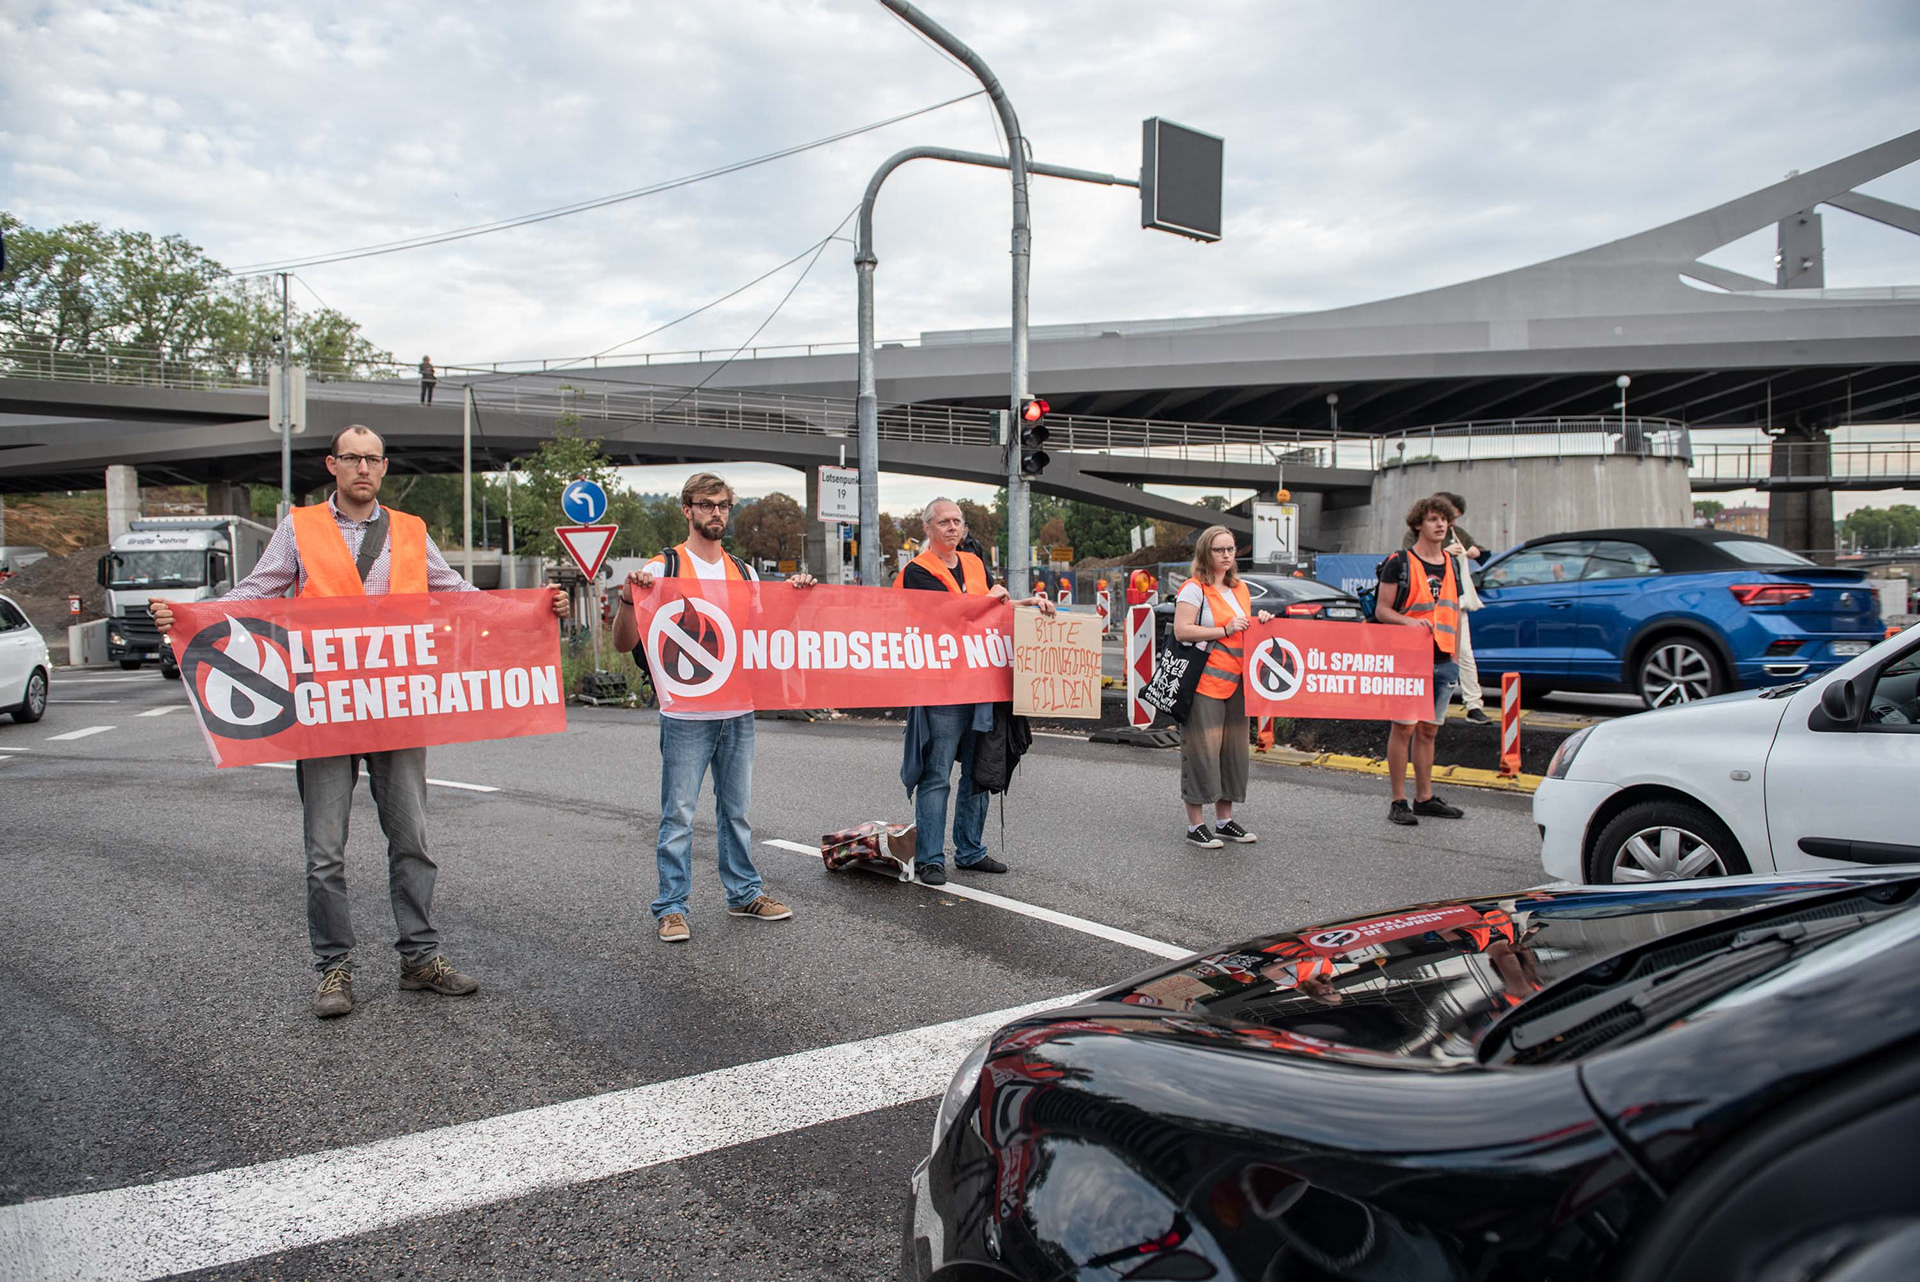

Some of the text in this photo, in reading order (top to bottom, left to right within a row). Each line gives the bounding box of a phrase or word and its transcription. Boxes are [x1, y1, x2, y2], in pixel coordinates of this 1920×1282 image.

[821, 472, 860, 486] Lotsenpunk
[837, 489, 847, 499] 19
[1034, 617, 1082, 644] BITTE
[288, 624, 438, 673] LETZTE
[742, 626, 1014, 669] NORDSEEÖL? NÖ!
[1307, 648, 1394, 673] ÖL SPAREN
[1016, 645, 1102, 679] RETTUNGSGASSE
[1161, 656, 1184, 678] TREES
[1170, 655, 1190, 672] WITH
[294, 665, 559, 726] GENERATION
[1031, 676, 1093, 712] BILDEN
[1306, 674, 1425, 696] STATT BOHREN
